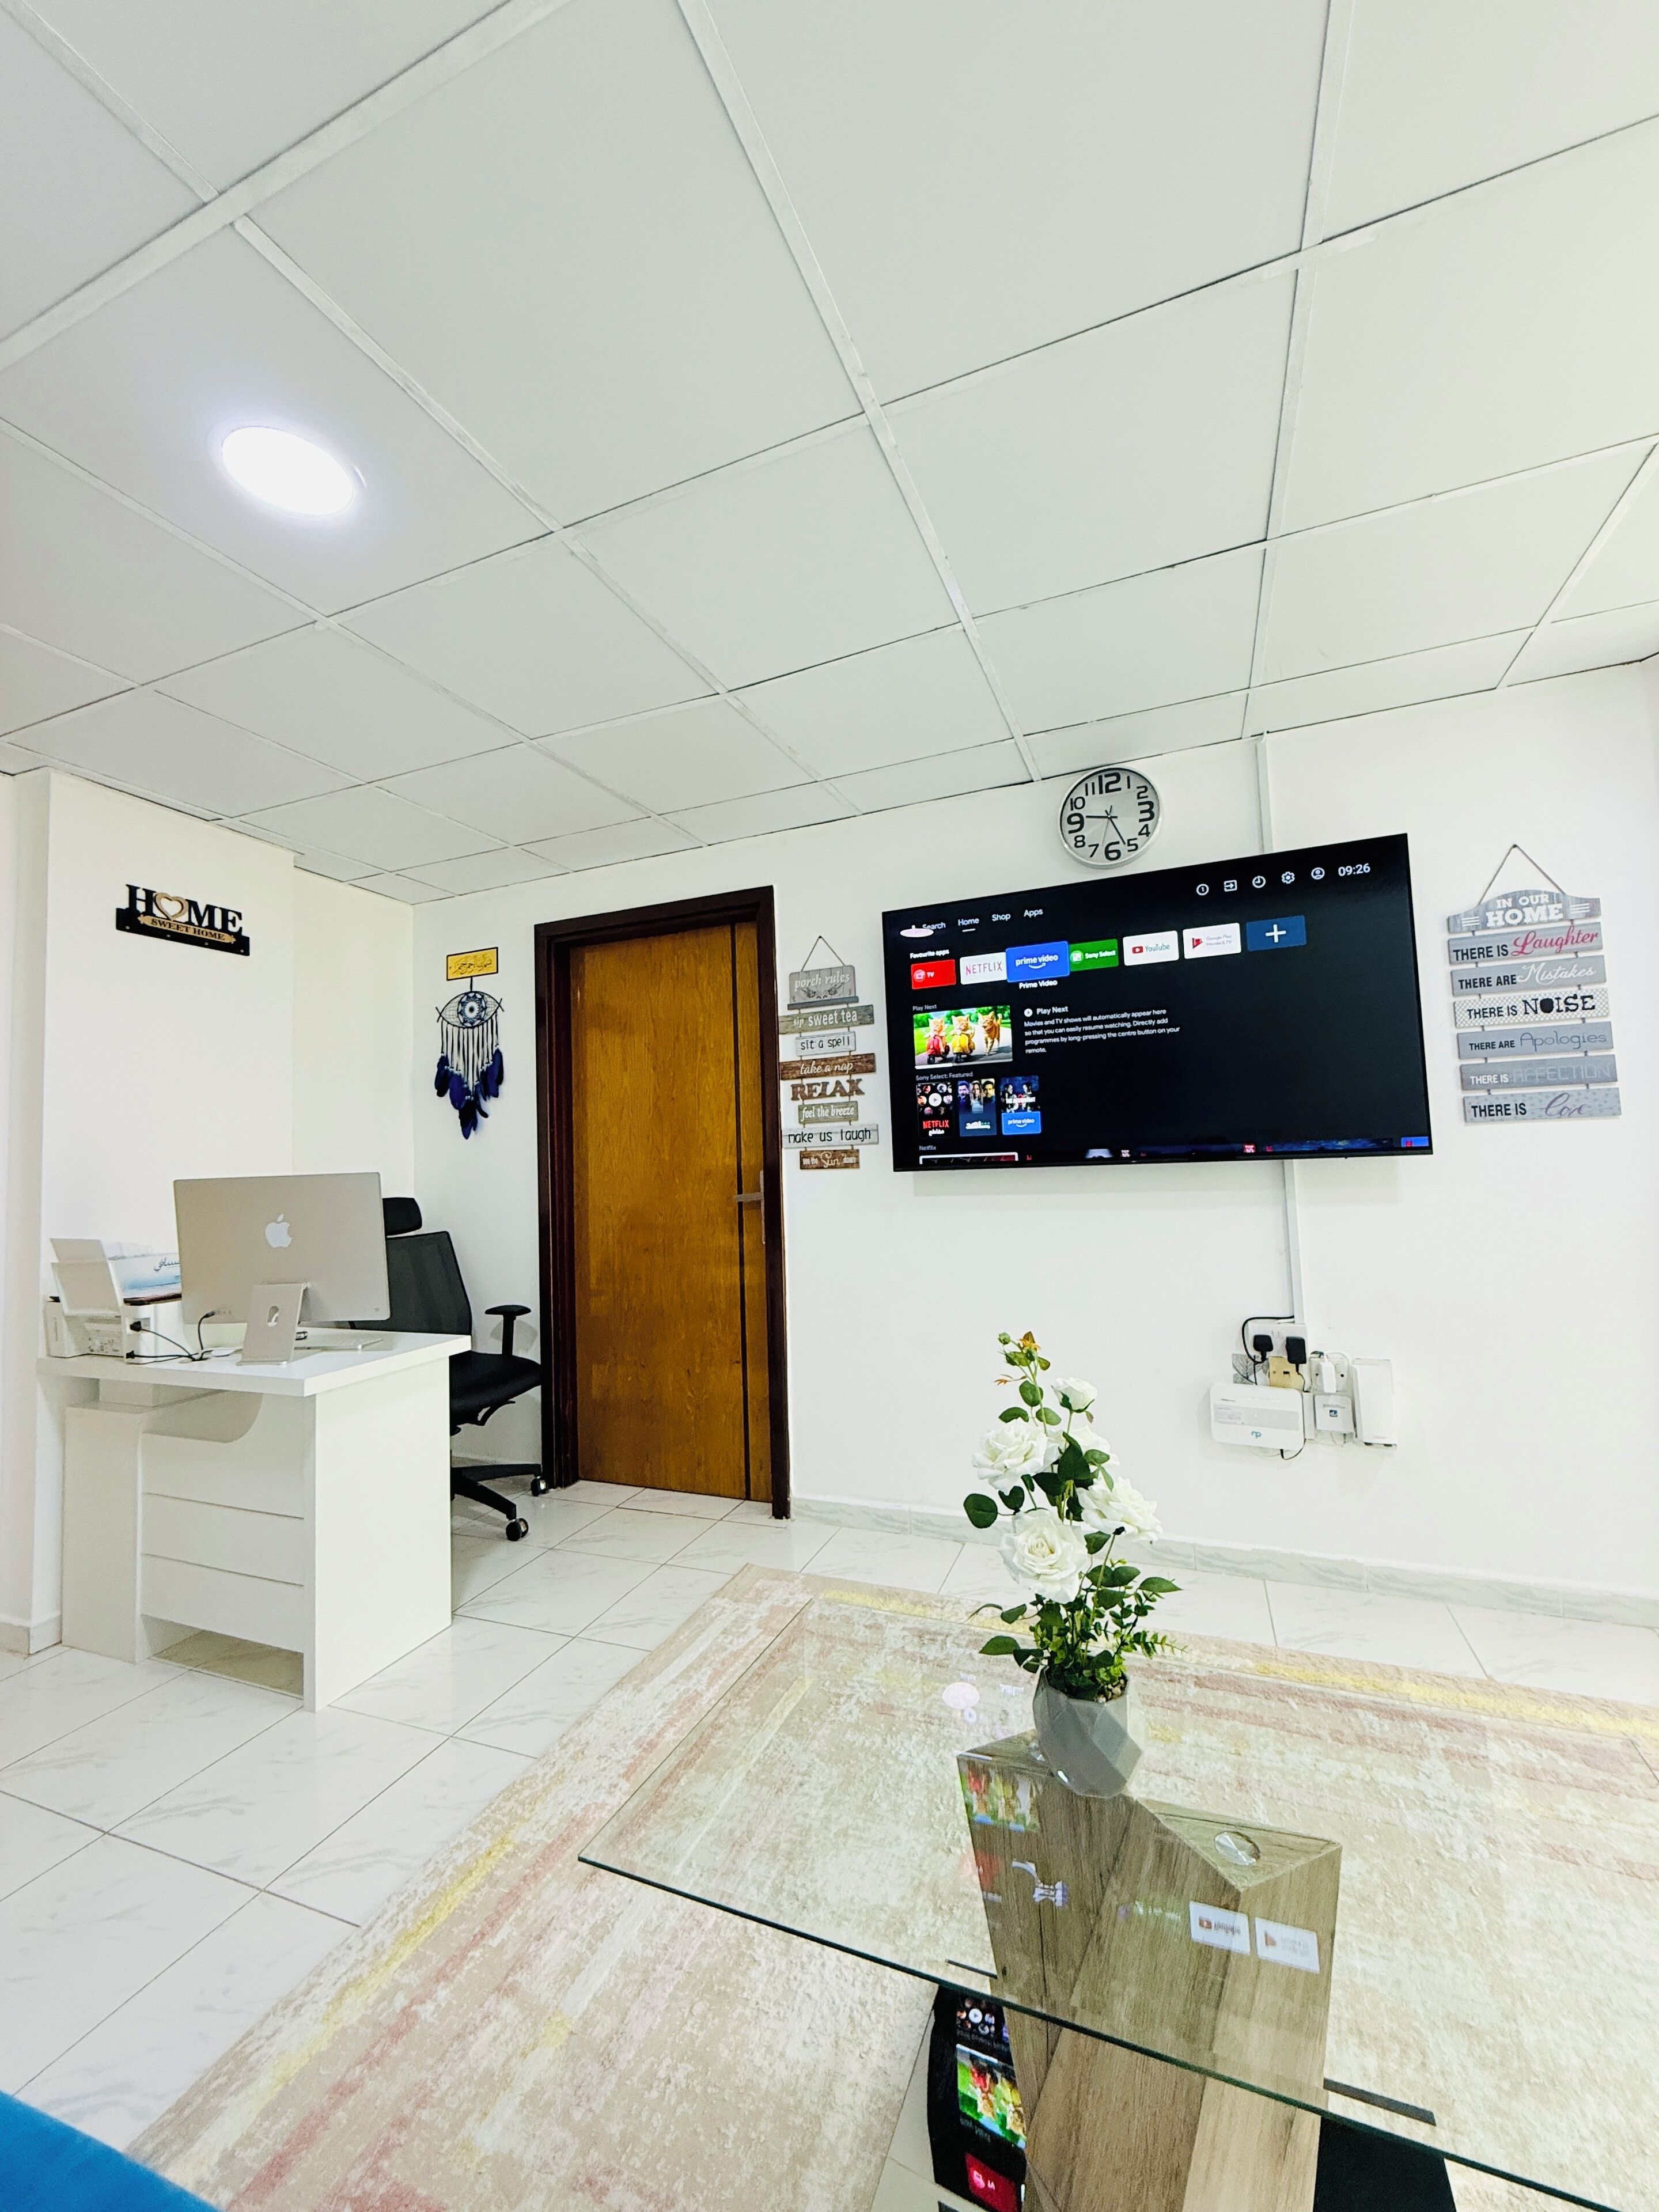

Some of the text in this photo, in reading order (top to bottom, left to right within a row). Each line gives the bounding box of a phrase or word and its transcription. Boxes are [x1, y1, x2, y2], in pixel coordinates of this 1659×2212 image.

[1085, 782, 1095, 796] 11
[1098, 772, 1122, 794] 12
[1127, 775, 1131, 789] 1
[1136, 785, 1149, 800] 2
[1070, 796, 1085, 811] 10
[1138, 801, 1155, 823] 3
[1067, 813, 1085, 834] 9
[1138, 824, 1150, 837] 4
[1074, 835, 1086, 848] 8
[1127, 838, 1138, 852] 5
[1088, 843, 1099, 858] 7
[1104, 841, 1121, 861] 6
[1338, 863, 1370, 876] 09:26
[1496, 893, 1550, 909] IN OUR
[958, 917, 979, 926] Home
[992, 913, 1011, 922] Shop
[1024, 908, 1043, 918] Apps
[1486, 903, 1563, 927] HOME
[151, 918, 225, 941] SWEET HOME
[1145, 943, 1170, 952] YouTube
[1453, 925, 1599, 961] THERE IS Laughter
[965, 961, 1003, 975] NETFLIX
[1016, 954, 1058, 967] prime video
[794, 971, 850, 992] porch rules
[1458, 962, 1596, 990] THERE ARE Mistakes
[1019, 981, 1037, 989] Prime
[1467, 994, 1596, 1019] THERE IS NOISE
[793, 1009, 857, 1028] sip sweet tea
[801, 1040, 815, 1050] sit
[828, 1036, 850, 1048] spell
[1469, 1031, 1607, 1052] THERE ARE Apologies
[800, 1060, 822, 1074] take
[834, 1062, 853, 1074] nap
[1470, 1065, 1611, 1085] THERE IS AFFECTION
[790, 1078, 865, 1100] RELAX
[801, 1104, 854, 1122] feel the breeze
[1471, 1104, 1512, 1118] THERE
[1515, 1103, 1527, 1115] IS
[923, 1120, 949, 1129] NETFLIX
[788, 1127, 871, 1143] make us laugh
[820, 1151, 840, 1168] Sun
